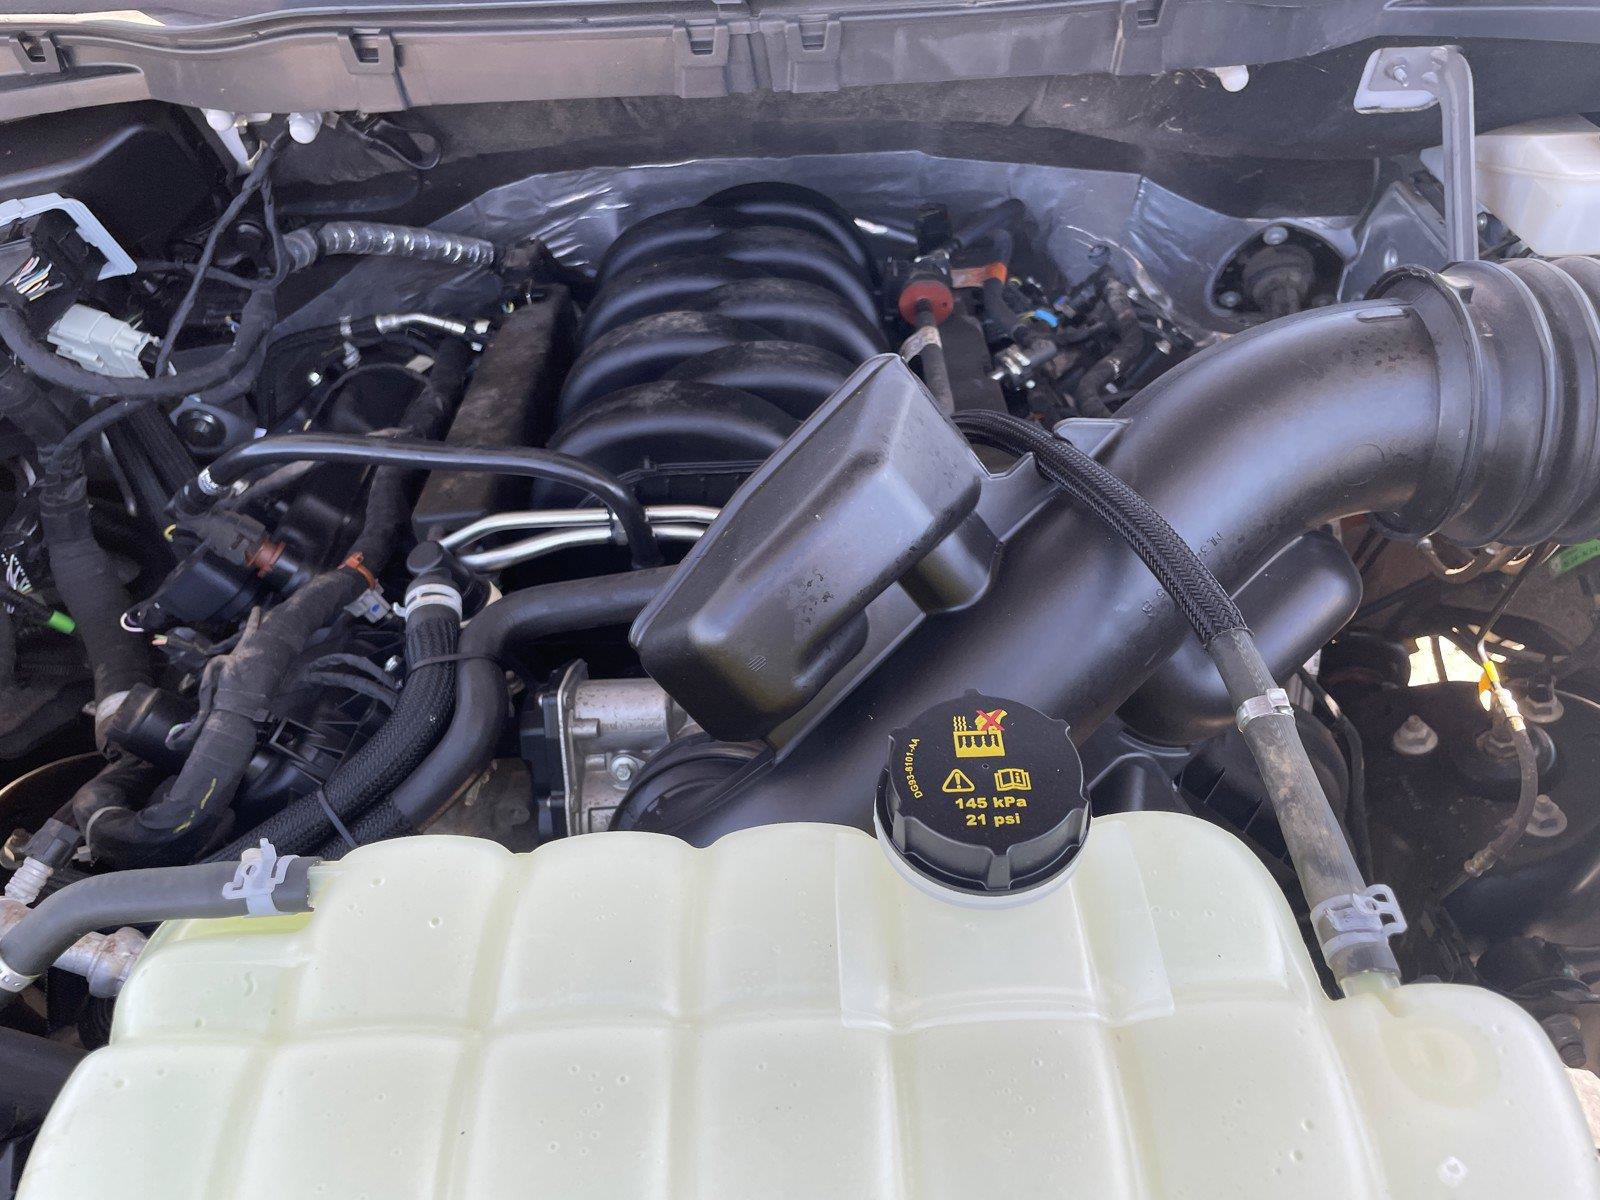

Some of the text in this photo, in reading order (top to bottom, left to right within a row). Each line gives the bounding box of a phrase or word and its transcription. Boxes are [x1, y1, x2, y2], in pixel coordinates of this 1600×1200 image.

[904, 738, 923, 799] DG93-8101-AA
[955, 796, 1027, 809] 145 kPa
[965, 812, 1020, 828] 21 psi
